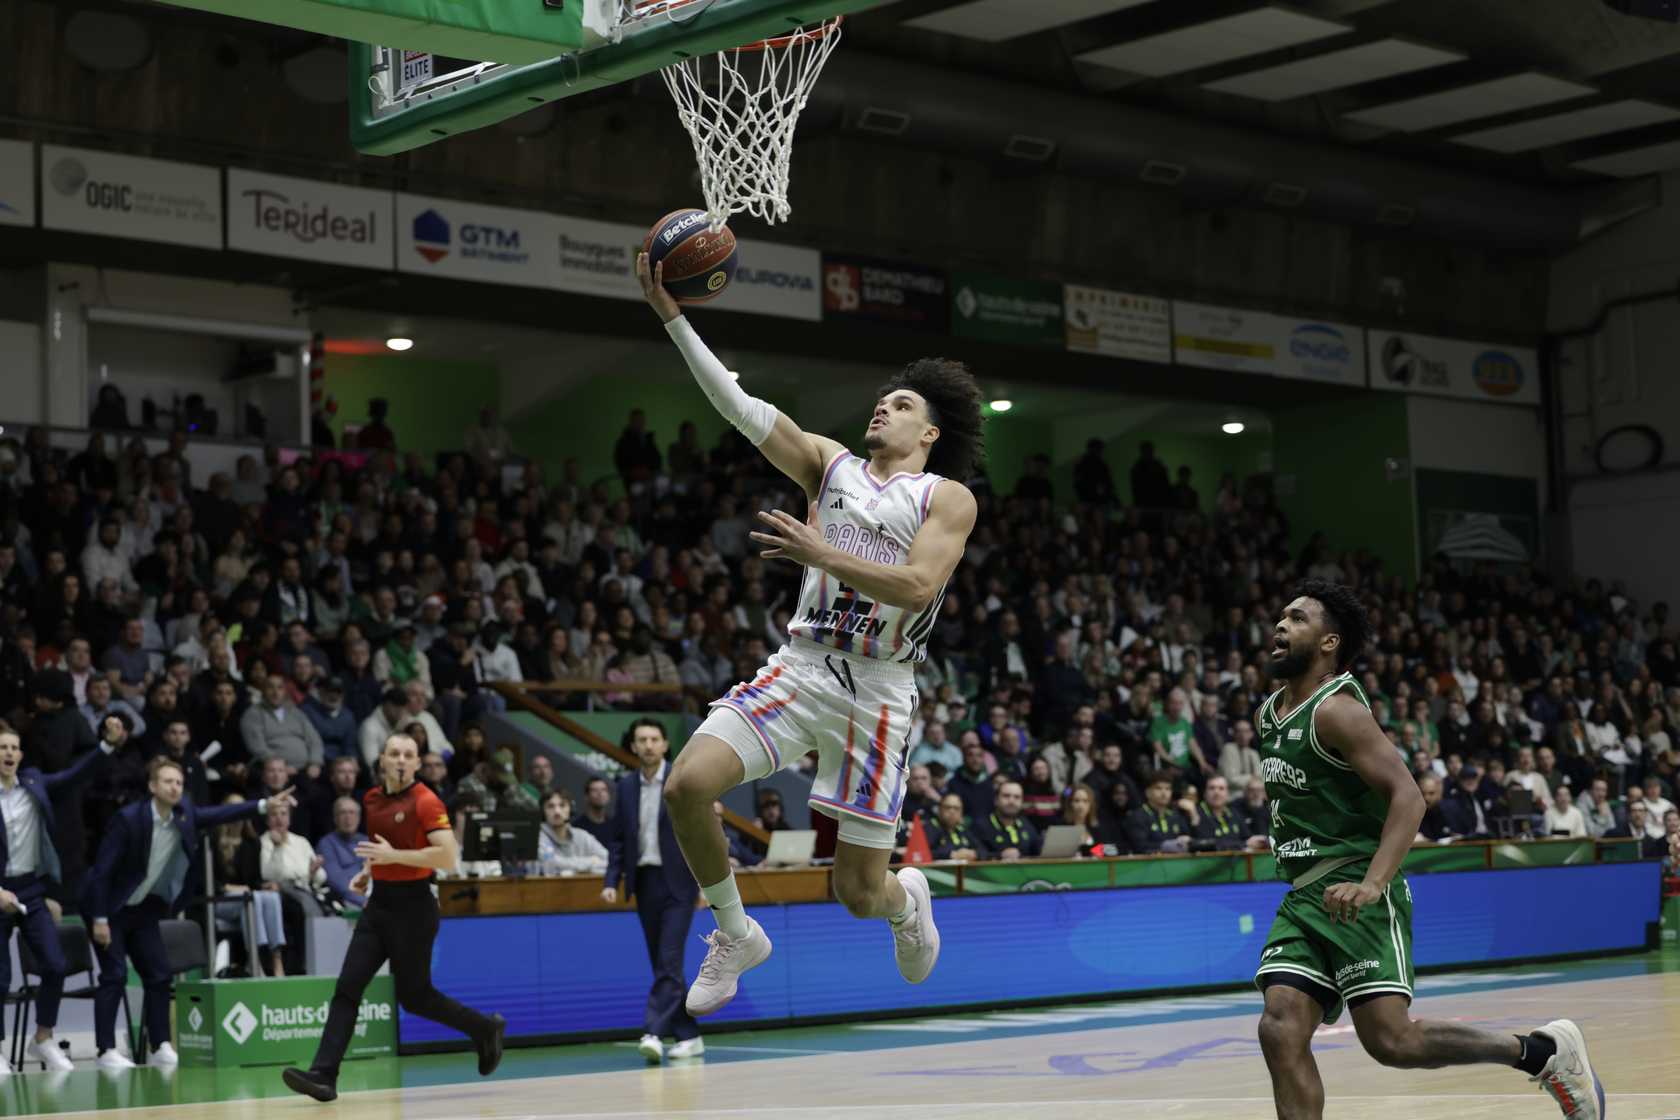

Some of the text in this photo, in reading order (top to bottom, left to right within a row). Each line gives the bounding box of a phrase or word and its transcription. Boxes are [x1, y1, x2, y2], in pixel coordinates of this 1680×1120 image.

[404, 59, 429, 80] ELITE
[86, 181, 132, 211] OGIC
[460, 225, 520, 248] GTM
[824, 523, 899, 566] PARIS
[803, 607, 888, 636] MENNEN
